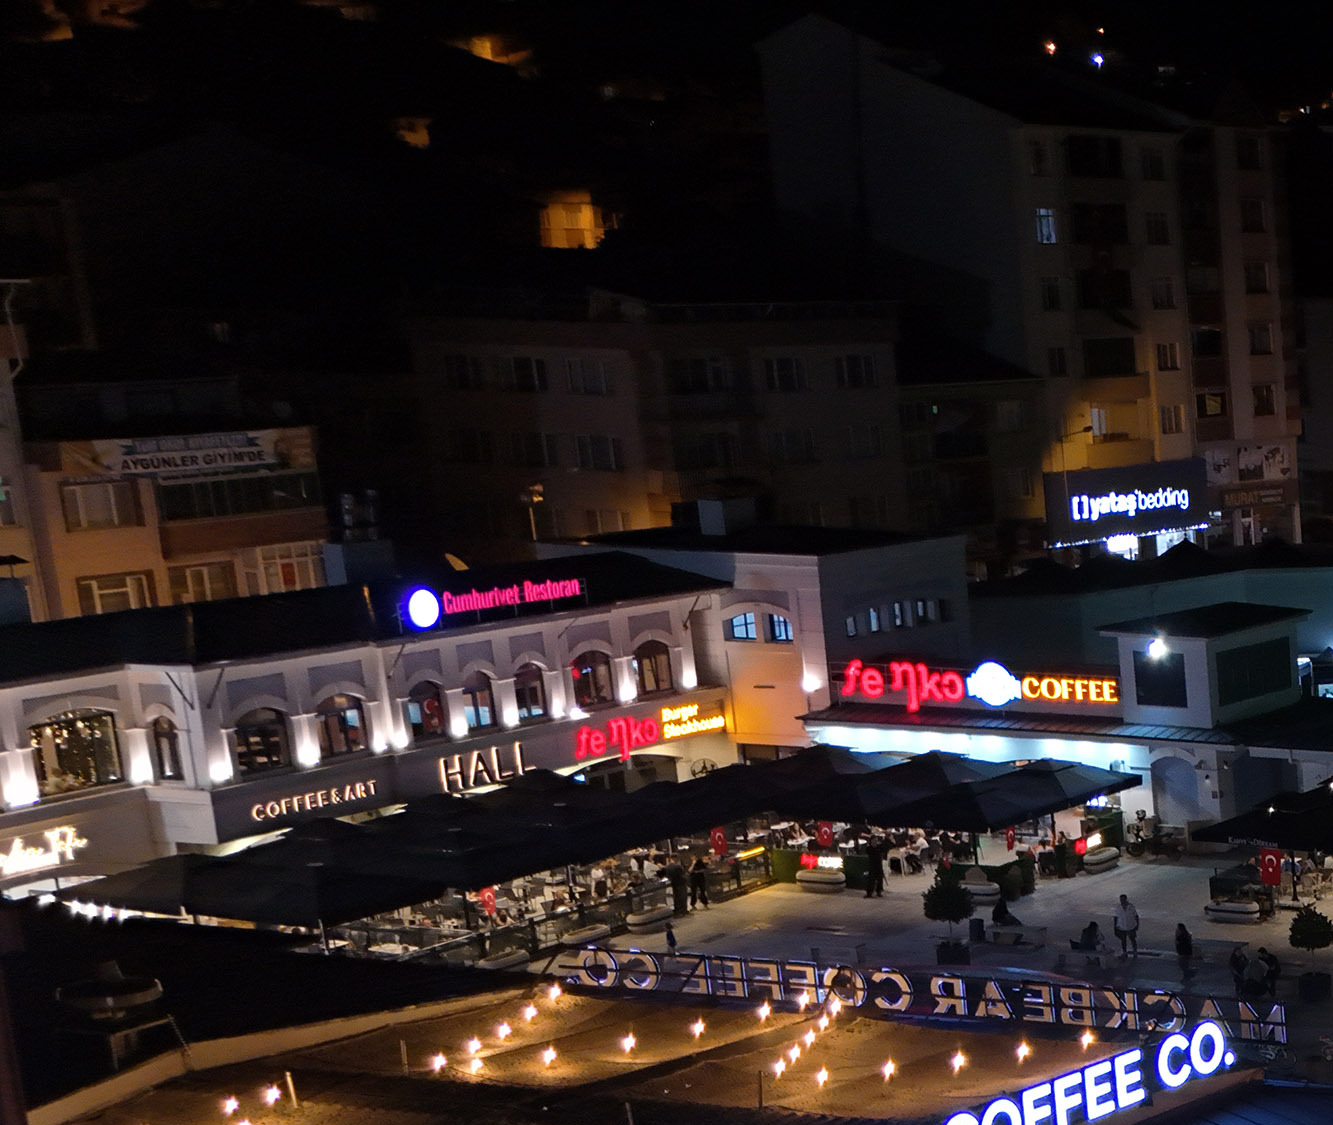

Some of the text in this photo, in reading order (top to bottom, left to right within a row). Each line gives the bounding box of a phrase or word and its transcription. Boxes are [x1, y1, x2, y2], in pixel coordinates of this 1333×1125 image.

[121, 453, 199, 472] AYGÜNLER
[1137, 487, 1189, 512] bedding
[523, 577, 581, 603] Restoran
[1021, 674, 1119, 704] COFFEE
[439, 740, 537, 793] HALL
[1156, 1017, 1236, 1092] CO.
